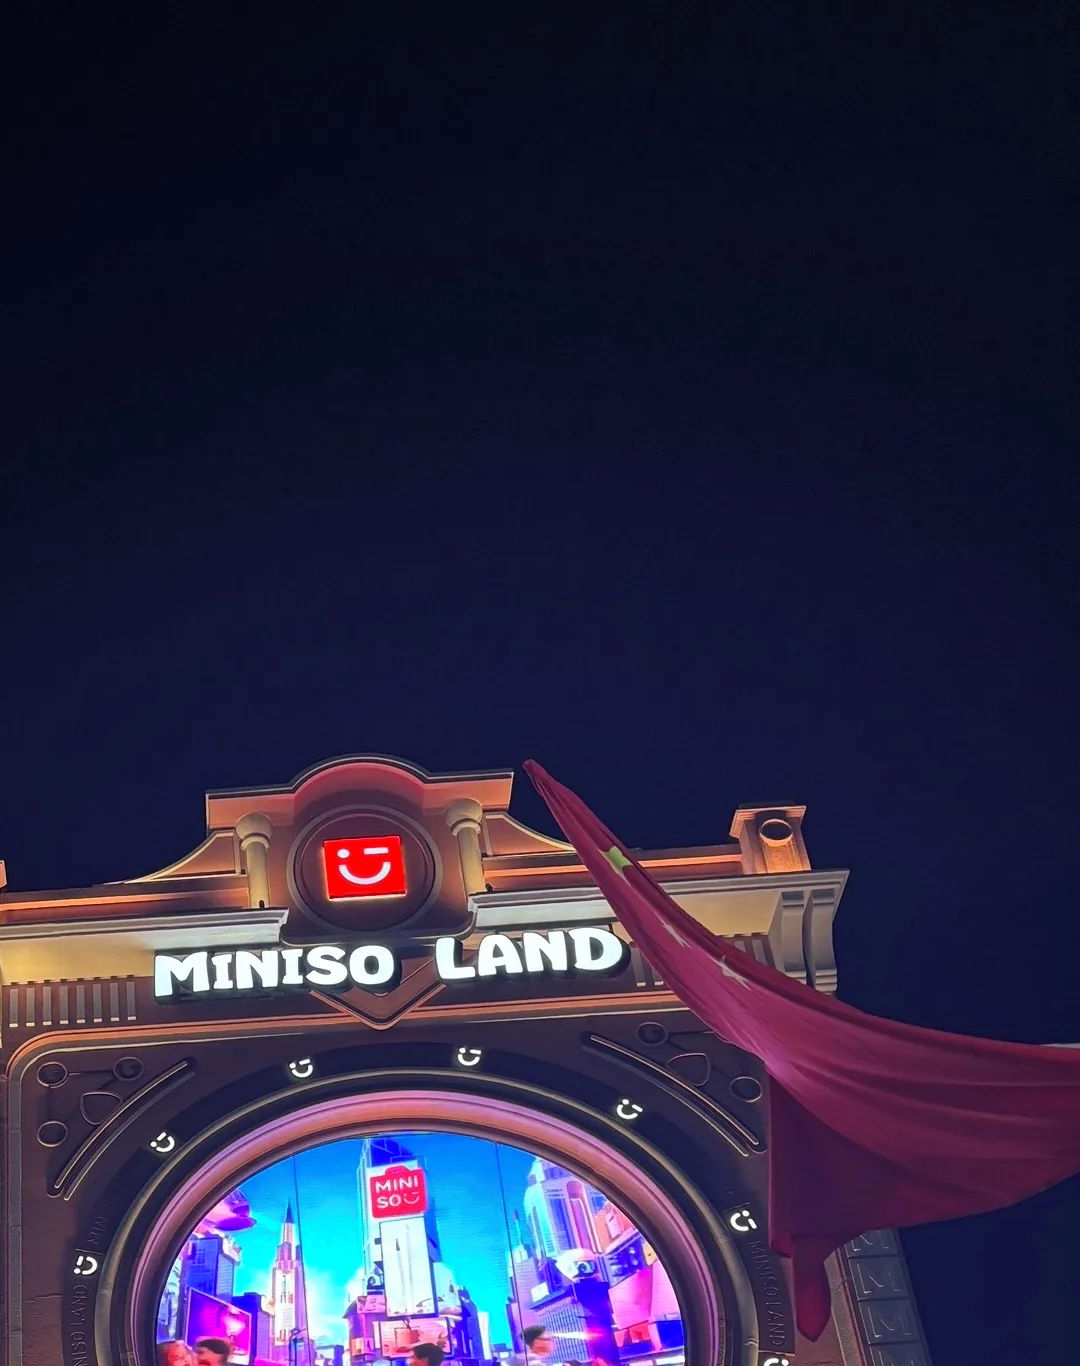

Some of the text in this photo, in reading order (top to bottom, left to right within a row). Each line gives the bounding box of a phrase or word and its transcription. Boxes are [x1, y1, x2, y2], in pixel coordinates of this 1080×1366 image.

[154, 928, 623, 998] MINISO LAND
[375, 1175, 419, 1193] MINI
